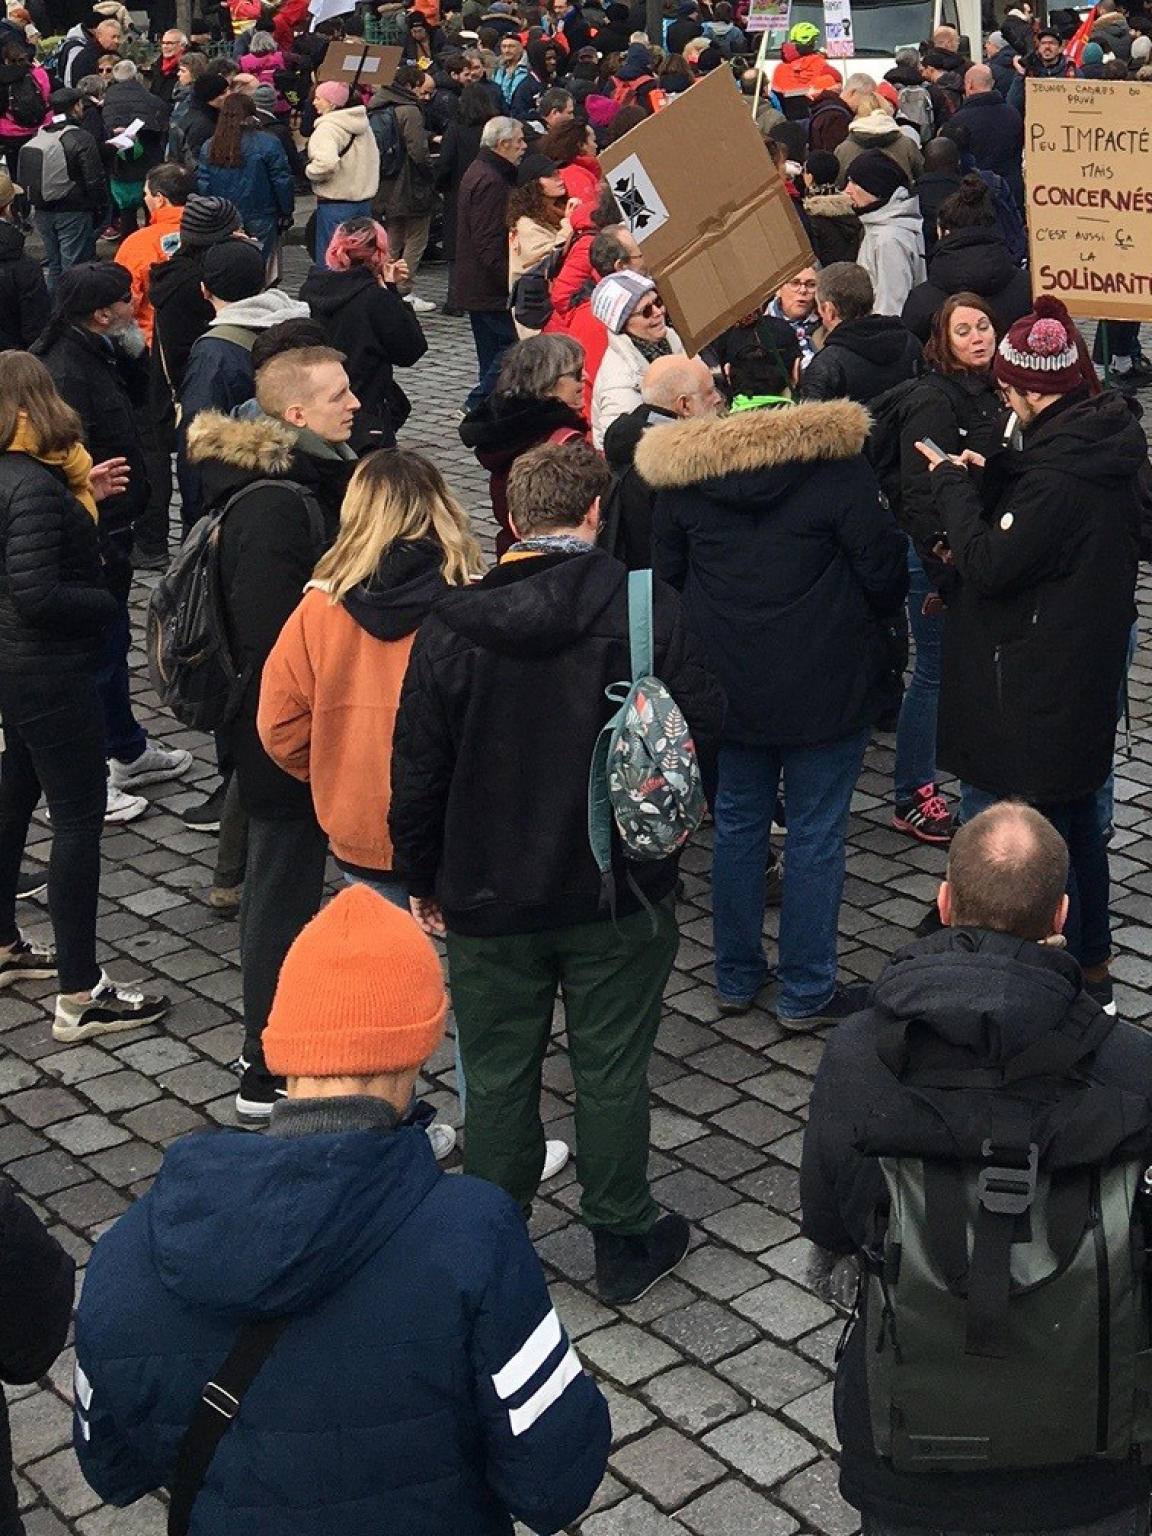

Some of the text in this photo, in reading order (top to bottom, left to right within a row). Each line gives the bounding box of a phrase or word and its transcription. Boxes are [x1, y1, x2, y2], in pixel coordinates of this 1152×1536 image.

[1075, 84, 1115, 96] CADRES
[1036, 228, 1067, 242] C'EST
[1080, 252, 1096, 262] LA
